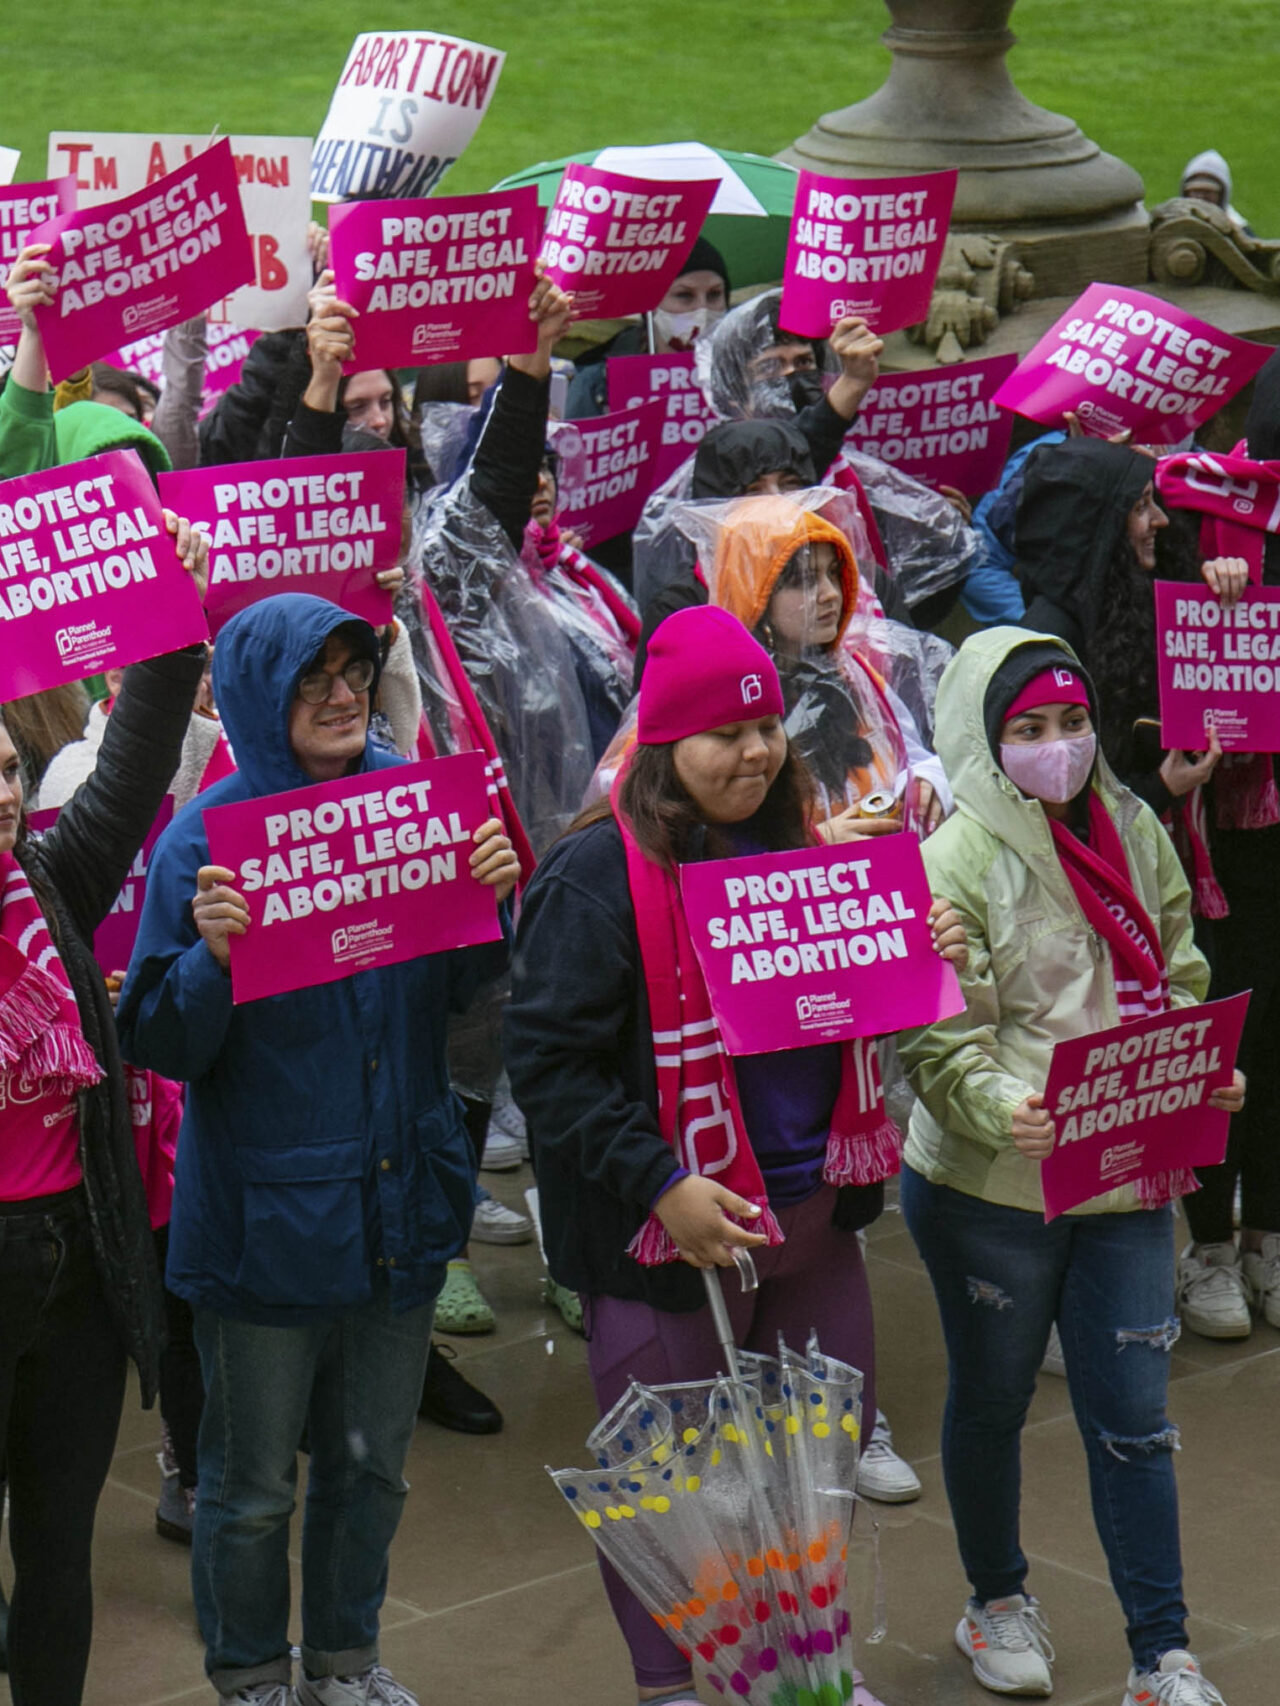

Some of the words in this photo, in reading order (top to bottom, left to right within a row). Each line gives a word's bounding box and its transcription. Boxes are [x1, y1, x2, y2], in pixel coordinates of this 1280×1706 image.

[342, 37, 499, 110] ABORTION
[368, 96, 419, 144] IS
[147, 142, 167, 186] A
[60, 174, 199, 257] PROTECT
[558, 179, 683, 219] PROTECT
[807, 189, 928, 222] PROTECT
[140, 192, 227, 255] LEGAL
[381, 208, 512, 246] PROTECT
[546, 208, 597, 248] AFE,
[606, 221, 687, 248] LEGAL
[795, 217, 854, 256] SAFE,
[862, 219, 938, 252] LEGAL
[60, 223, 222, 318] ABORTION
[353, 250, 439, 281] SAFE,
[446, 238, 528, 272] LEGAL
[794, 249, 926, 285] ABORTION
[366, 271, 517, 313] ABORTION
[1058, 318, 1128, 366] SAFE,
[1136, 348, 1231, 398] LEGAL
[1093, 299, 1231, 370] PROTECT
[858, 373, 985, 411] PROTECT
[1045, 344, 1206, 416] ABORTION
[846, 412, 912, 438] AFE,
[921, 400, 1001, 432] LEGAL
[584, 441, 650, 482] LEGAL
[213, 471, 364, 513] PROTECT
[52, 507, 159, 563] LEGAL
[190, 514, 288, 549] SAFE,
[296, 504, 386, 541] LEGAL
[211, 539, 375, 585] ABORTION
[1175, 599, 1280, 629] PROTECT
[1165, 630, 1217, 663] SAFE,
[264, 780, 432, 847] PROTECT
[240, 841, 345, 891] SAFE,
[354, 812, 471, 865] LEGAL
[261, 850, 457, 926] ABORTION
[724, 859, 871, 908] PROTECT
[707, 909, 799, 949] SAFE,
[804, 891, 915, 935] LEGAL
[730, 928, 908, 984] ABORTION
[1084, 1018, 1213, 1076] PROTECT
[1055, 1071, 1129, 1115] SAFE,
[1135, 1046, 1222, 1091] LEGAL
[1058, 1080, 1205, 1147] ABORTION
